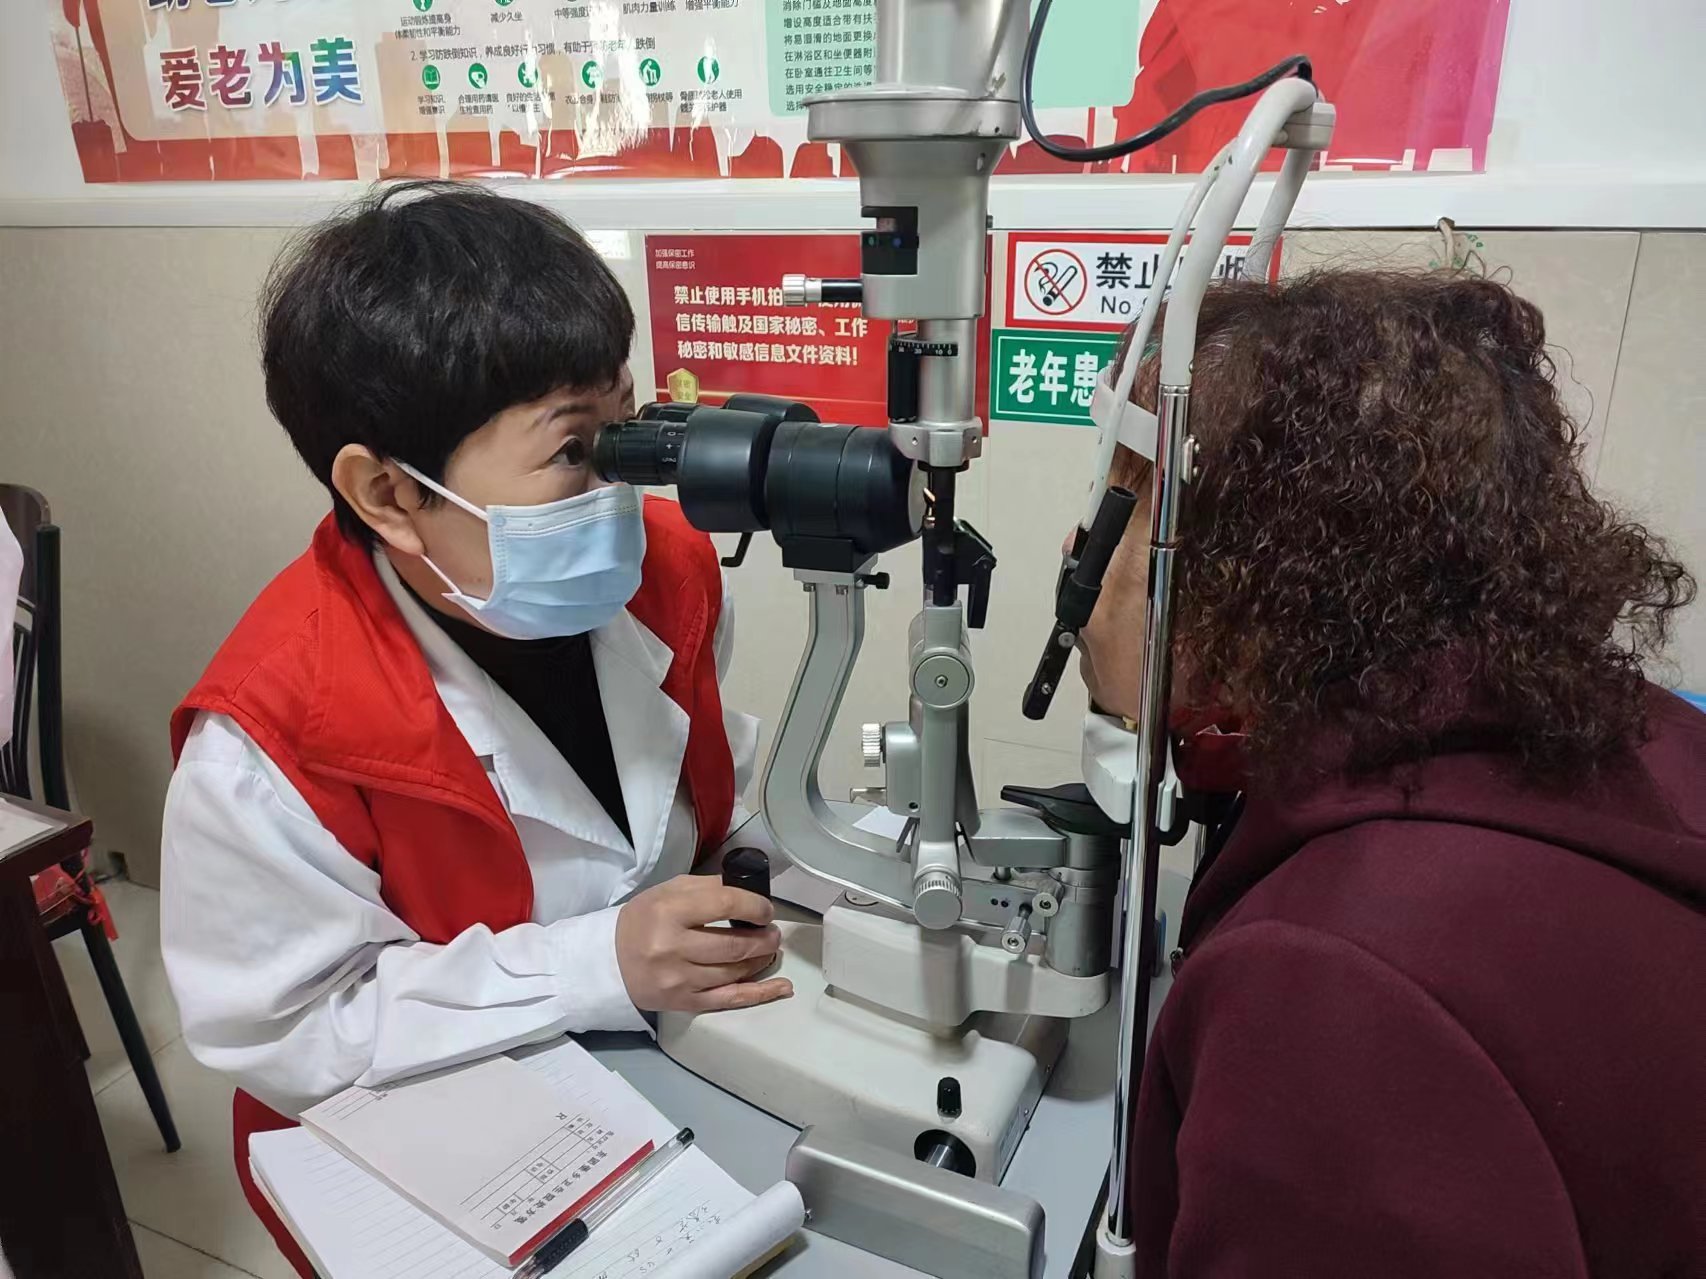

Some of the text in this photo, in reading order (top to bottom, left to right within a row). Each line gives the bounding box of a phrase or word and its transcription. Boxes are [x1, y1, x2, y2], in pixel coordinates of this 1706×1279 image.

[623, 1, 677, 14] 肌肉力量训练
[783, 0, 877, 11] 消除门槛及地面高度
[491, 11, 524, 24] 减少久坐
[783, 13, 878, 29] 增设高度适合带有扶
[784, 30, 877, 46] 将易湿滑的地面更换
[784, 47, 877, 63] 在淋浴区和坐便器附
[159, 37, 363, 109] 爱老为美
[785, 64, 877, 79] 在卧室通往卫生间等
[674, 286, 862, 308] 禁止使用手机拍
[1100, 295, 1131, 314] No
[675, 313, 868, 338] 信传输触及国家秘密、工作
[1009, 349, 1116, 407] 老年患
